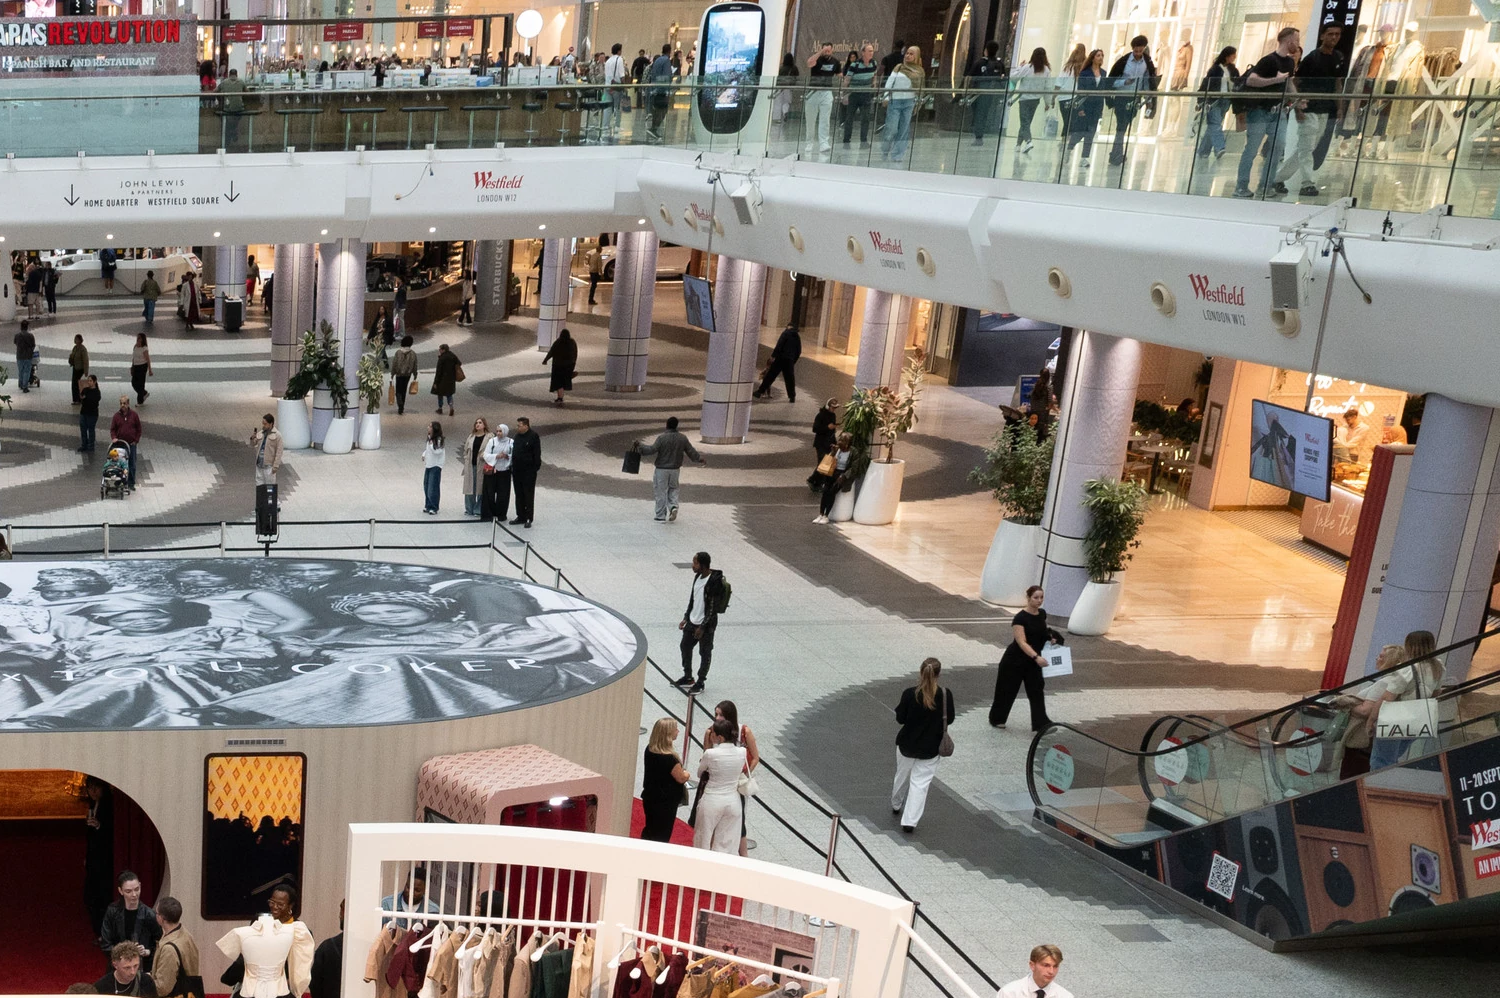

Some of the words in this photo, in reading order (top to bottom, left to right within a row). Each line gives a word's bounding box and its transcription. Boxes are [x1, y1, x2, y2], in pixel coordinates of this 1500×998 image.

[47, 19, 181, 46] REVOLUTION
[4, 57, 47, 69] SPANISH
[48, 58, 68, 68] BAR
[69, 57, 92, 68] AND
[93, 56, 157, 68] RESTAURANT
[120, 180, 148, 188] JOHN
[151, 179, 185, 187] LEWIS
[473, 170, 525, 190] Westfield
[84, 199, 103, 208] HOME
[106, 198, 139, 207] QUARTER
[148, 197, 188, 206] WESTFIELD
[191, 196, 220, 205] SQUARE
[477, 194, 503, 203] LONDON
[504, 193, 517, 202] W12
[868, 230, 904, 255] Westfield
[492, 240, 505, 306] STARBUCKS
[1187, 273, 1246, 307] Westfield
[1202, 309, 1231, 324] LONDON
[1231, 313, 1247, 326] W12
[1313, 500, 1335, 534] Take
[1338, 503, 1356, 537] the
[54, 660, 244, 682] TOLU
[290, 657, 547, 676] COKER
[1478, 858, 1490, 876] AN
